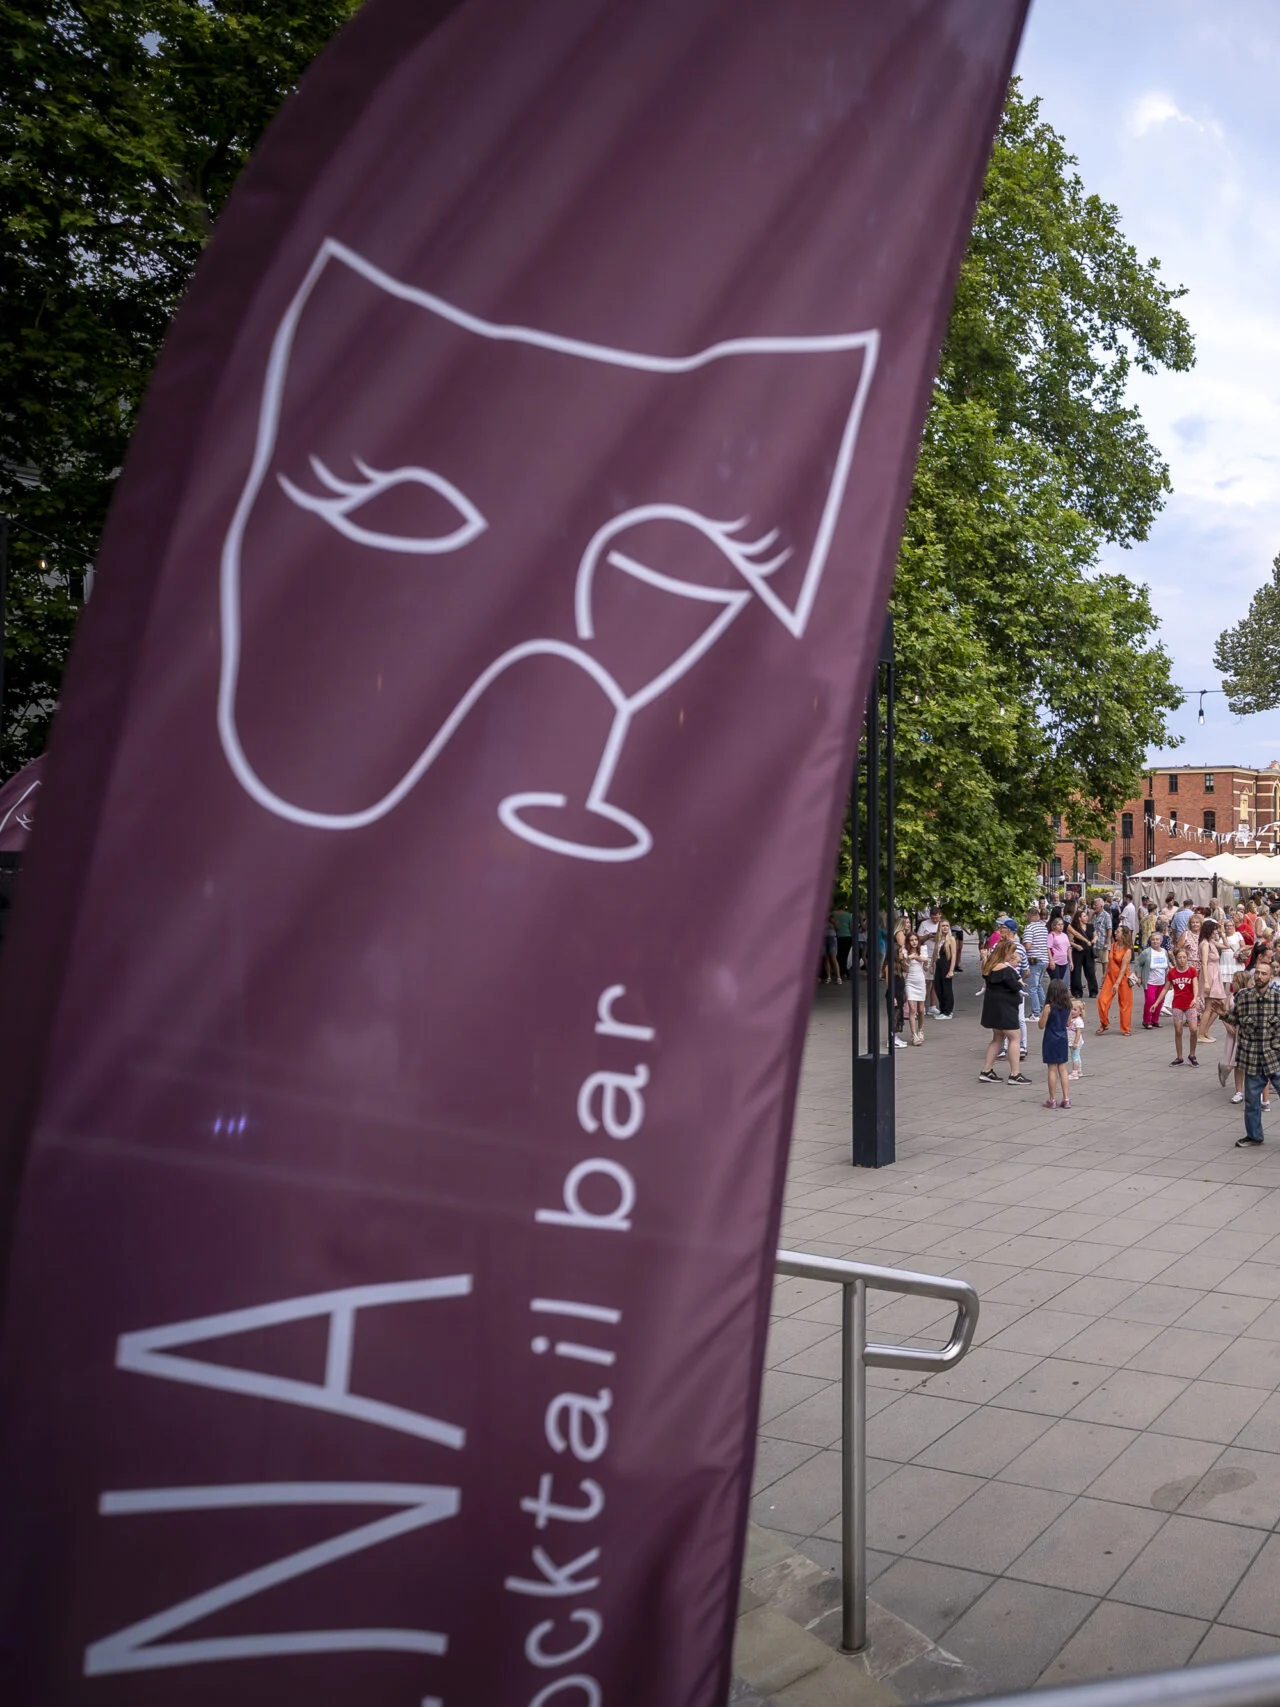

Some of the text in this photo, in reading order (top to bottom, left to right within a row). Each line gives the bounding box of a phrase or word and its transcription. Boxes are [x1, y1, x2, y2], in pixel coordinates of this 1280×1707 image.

[1172, 977, 1192, 985] POLSKA
[534, 983, 656, 1232] bar
[83, 1274, 474, 1707] NA
